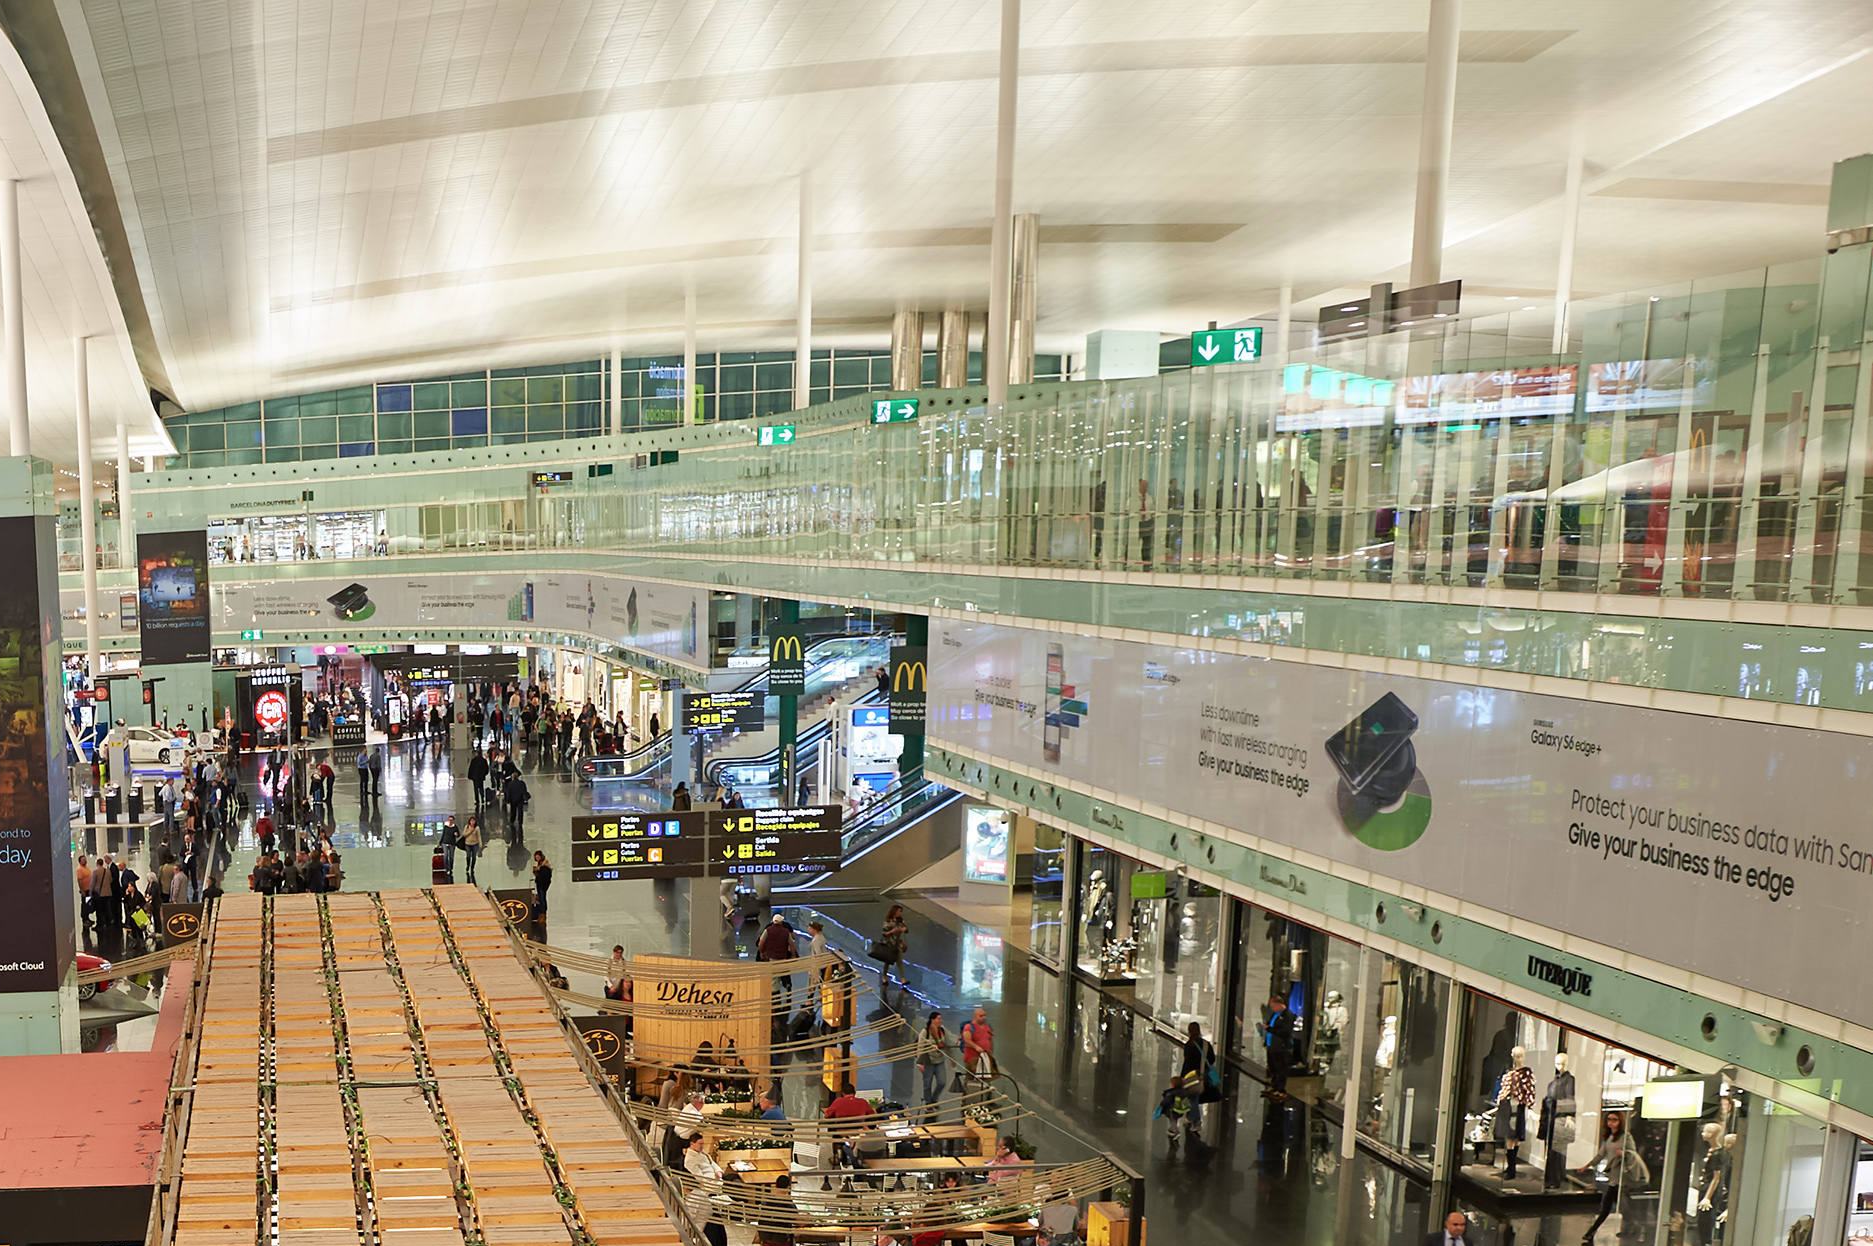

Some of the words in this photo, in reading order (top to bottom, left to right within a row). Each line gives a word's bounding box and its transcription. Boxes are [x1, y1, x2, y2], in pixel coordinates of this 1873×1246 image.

[975, 689, 985, 703] Give
[985, 694, 996, 707] your
[995, 693, 1015, 710] business
[1024, 701, 1037, 718] edge
[1201, 701, 1218, 719] Less
[1218, 705, 1259, 727] downtime
[1200, 725, 1217, 744] with
[1218, 727, 1233, 747] fast
[1234, 733, 1267, 755] wireless
[1268, 741, 1308, 770] charging
[1530, 729, 1563, 752] Galaxy
[1563, 734, 1575, 750] S6
[1198, 750, 1216, 769] Give
[1216, 757, 1234, 776] your
[1234, 759, 1269, 783] business
[1270, 767, 1285, 787] the
[1286, 773, 1310, 798] edge
[20, 829, 32, 839] to
[650, 823, 660, 835] D
[668, 822, 676, 834] E
[1571, 788, 1626, 821] Protect
[1628, 802, 1665, 830] your
[1667, 807, 1740, 846] business
[1744, 824, 1789, 856] data
[1794, 834, 1833, 866] with
[650, 849, 660, 862] C
[780, 864, 797, 873] Sky
[797, 863, 826, 872] Centre
[1568, 822, 1601, 852] Give
[1603, 832, 1638, 860] your
[1639, 838, 1710, 877] business
[1713, 855, 1742, 885] the
[1746, 866, 1795, 903] edge
[19, 961, 45, 971] Cloud
[657, 981, 734, 1006] Dehesa
